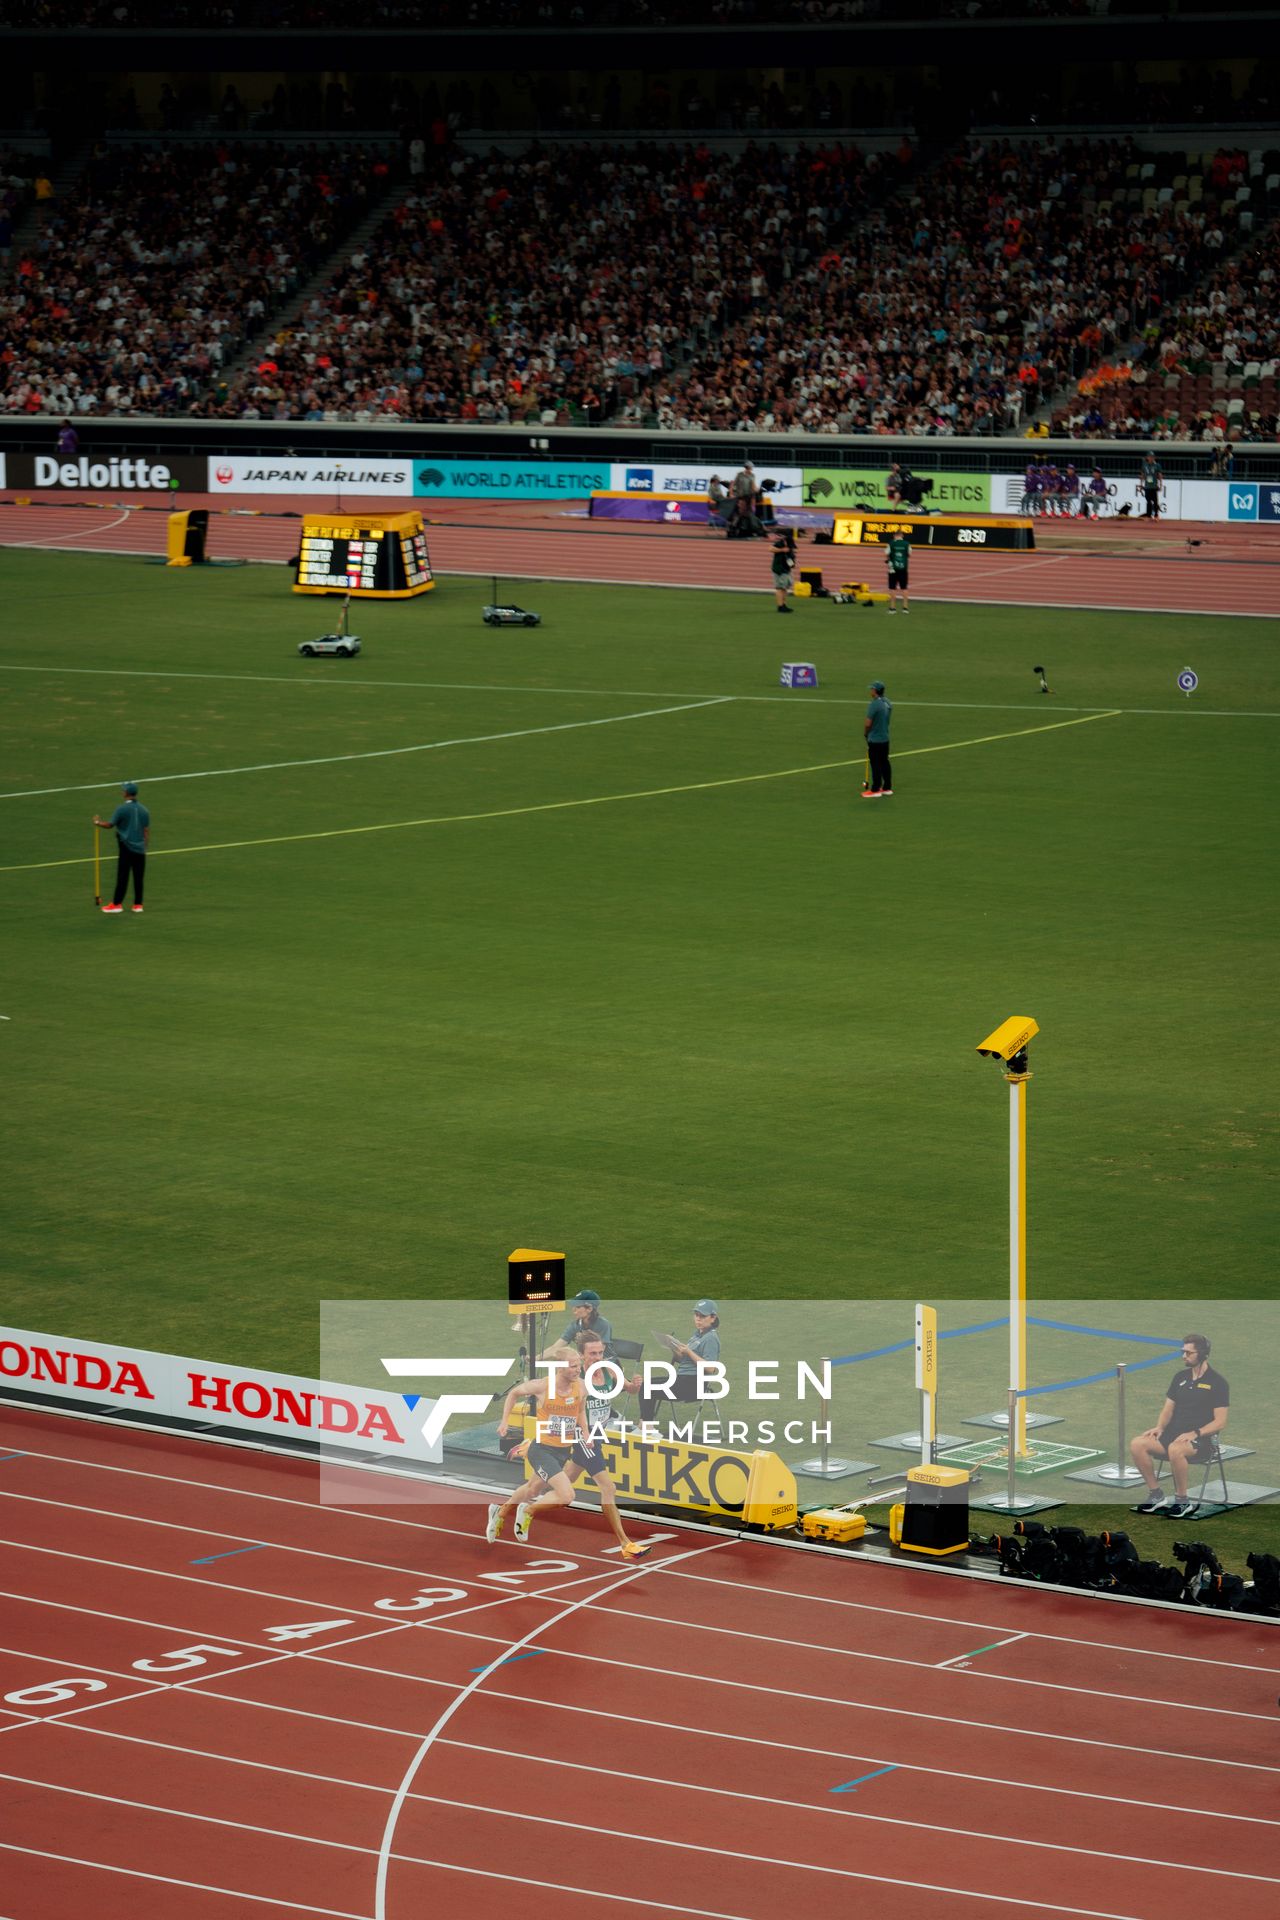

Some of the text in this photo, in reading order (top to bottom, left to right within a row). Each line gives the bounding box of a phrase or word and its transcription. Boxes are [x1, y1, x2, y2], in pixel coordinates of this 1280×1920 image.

[242, 470, 406, 484] JAPAN AIRLINES
[451, 472, 604, 489] WORLD ATHLETICS
[839, 481, 984, 500] WORL LETICS
[1007, 1032, 1029, 1056] SEIKO
[525, 1303, 554, 1312] SEIKO
[0, 1341, 155, 1400] ONDA
[187, 1372, 406, 1444] HONDA
[584, 1436, 751, 1512] EIKO
[913, 1472, 941, 1484] SEIKO
[771, 1503, 794, 1516] SEIKO
[477, 1560, 580, 1584] 2
[374, 1587, 468, 1611] 3
[262, 1619, 356, 1642] 4
[131, 1644, 243, 1672] 5
[4, 1678, 108, 1705] 6
